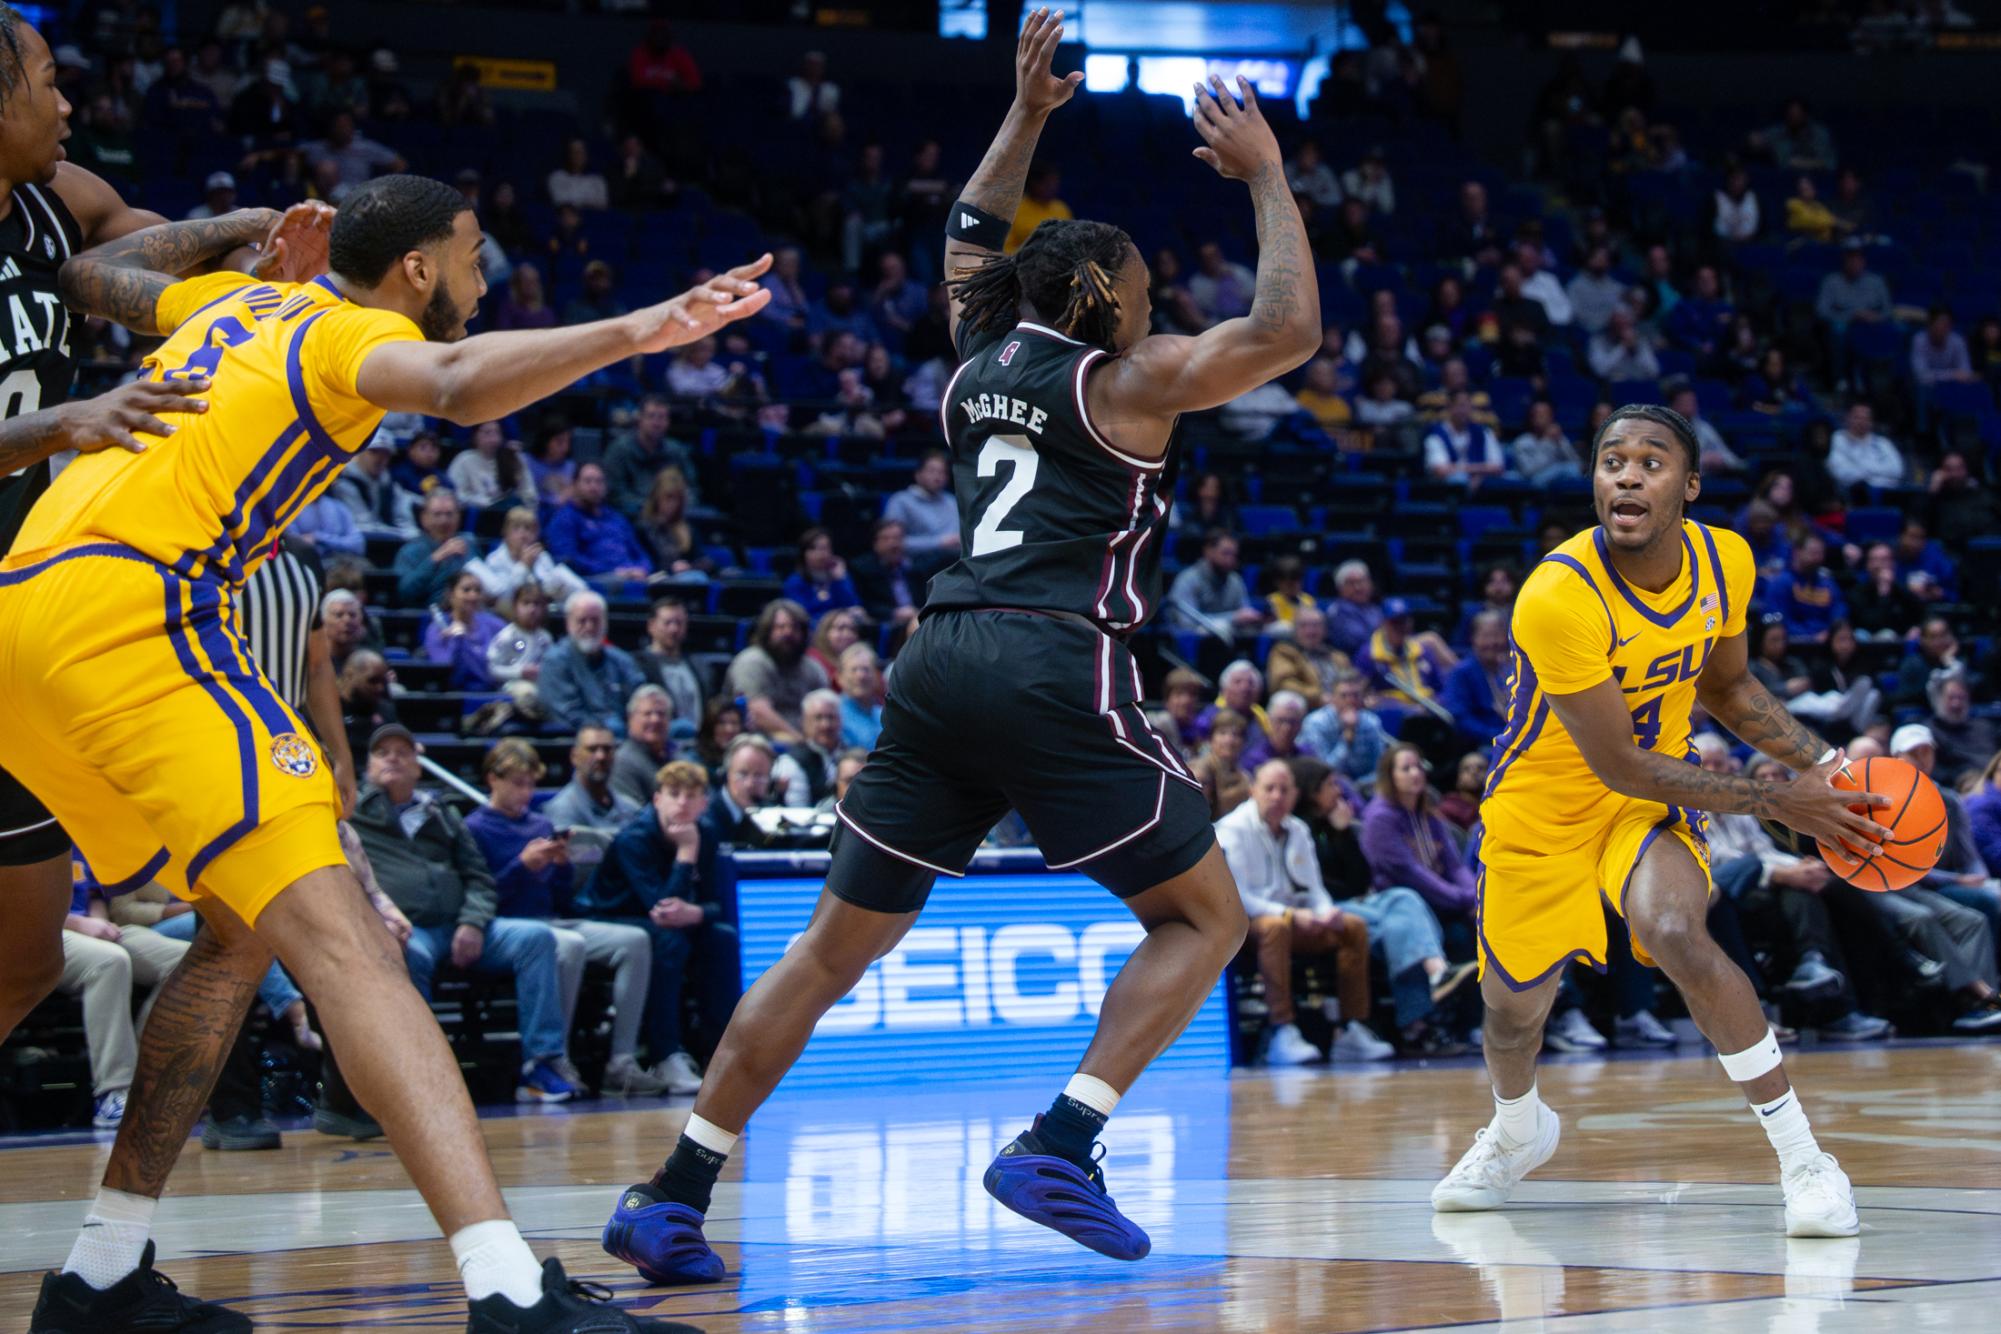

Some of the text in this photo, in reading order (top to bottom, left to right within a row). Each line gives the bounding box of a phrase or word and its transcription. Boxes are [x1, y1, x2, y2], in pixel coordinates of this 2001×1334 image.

[0, 290, 71, 365] ATE
[960, 392, 1048, 435] McGHEE
[971, 434, 1040, 558] 2
[1612, 635, 1714, 694] LSU
